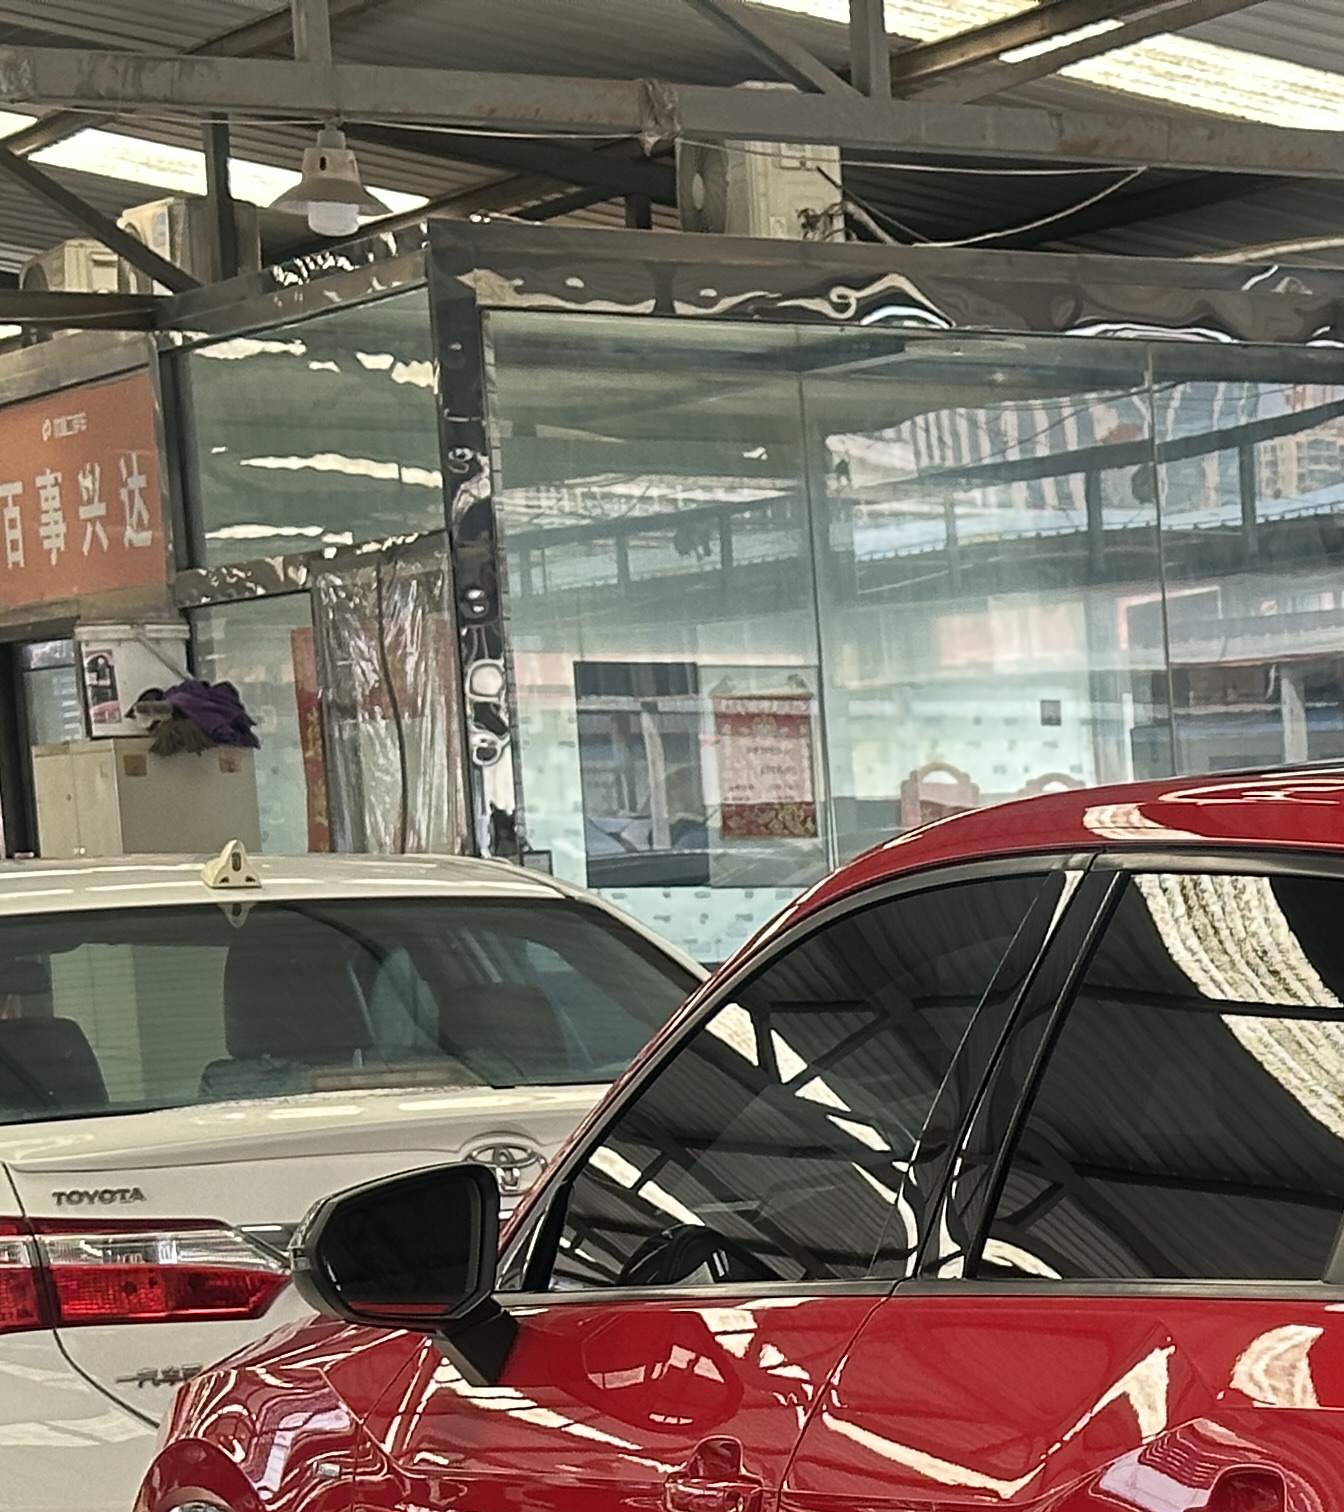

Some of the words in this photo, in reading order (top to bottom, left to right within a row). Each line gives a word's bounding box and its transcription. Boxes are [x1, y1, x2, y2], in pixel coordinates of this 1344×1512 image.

[0, 452, 153, 570] 百事兴达
[52, 1187, 147, 1206] TOYOTA
